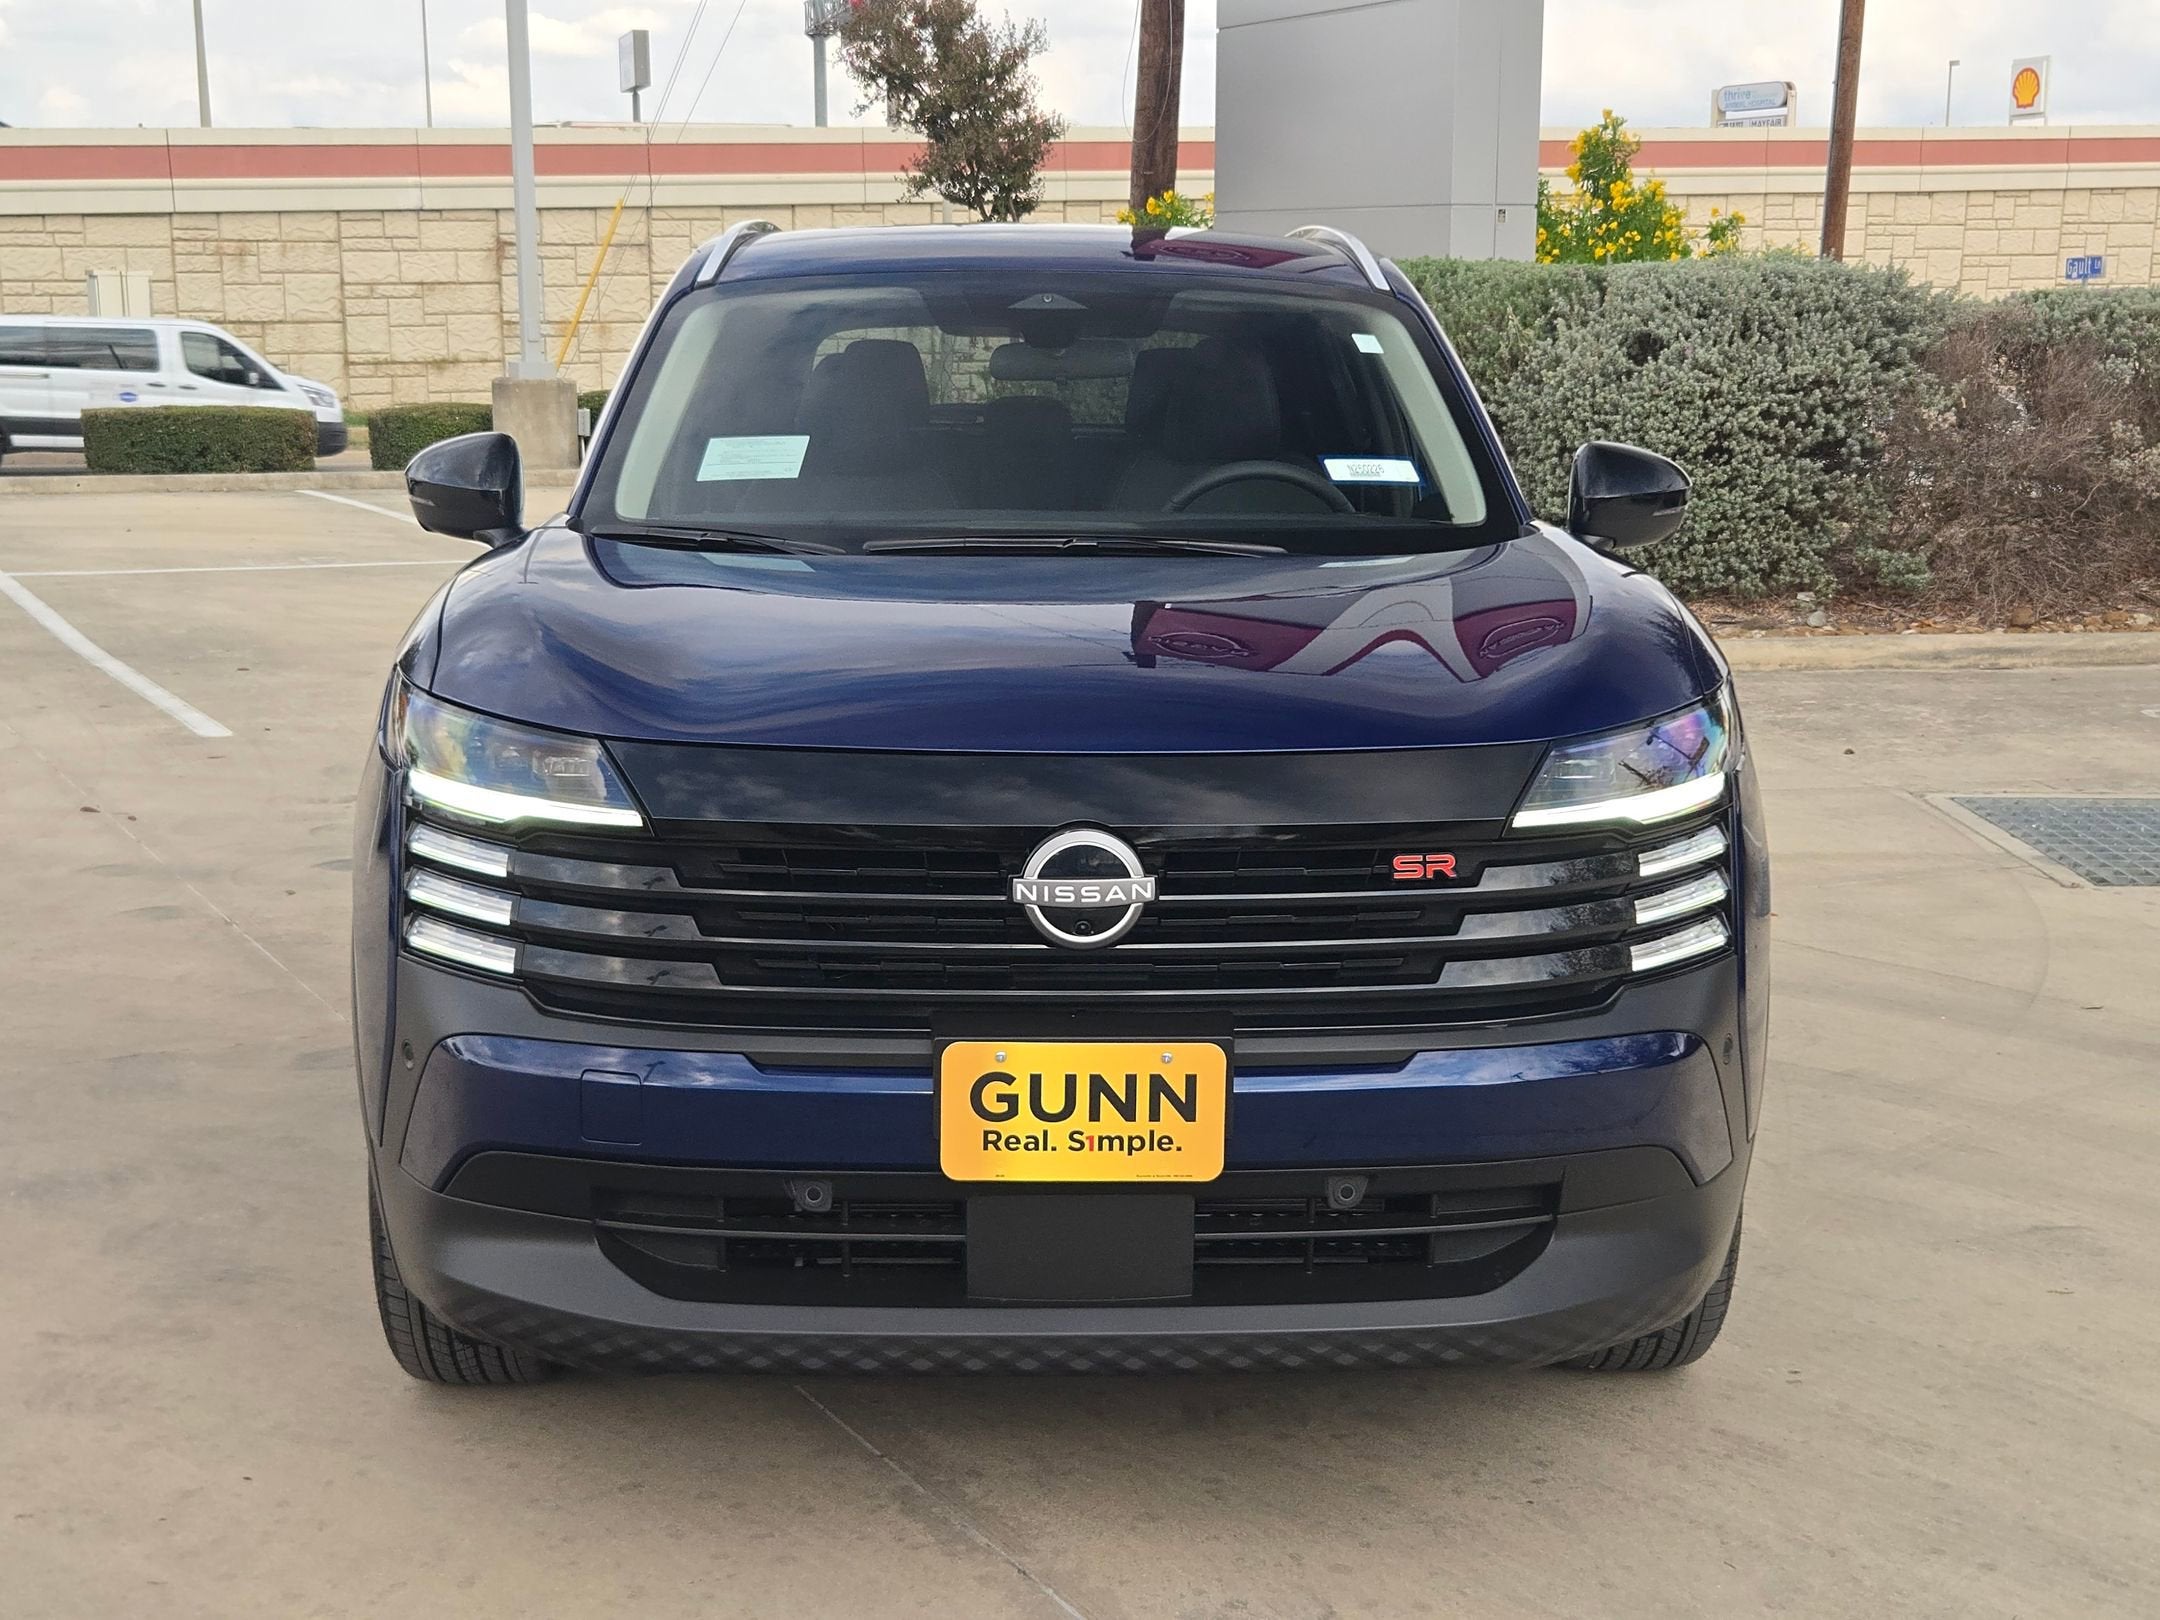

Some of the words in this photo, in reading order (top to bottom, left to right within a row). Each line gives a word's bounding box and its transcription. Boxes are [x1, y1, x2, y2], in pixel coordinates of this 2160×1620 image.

[1751, 118, 1782, 127] MAYFAIR
[2067, 258, 2091, 275] Gault
[1393, 854, 1457, 879] SR
[1016, 881, 1152, 903] NISSAN
[969, 1071, 1197, 1123] GUNN
[982, 1129, 1057, 1152] Real.
[1068, 1129, 1182, 1156] S1mple.
